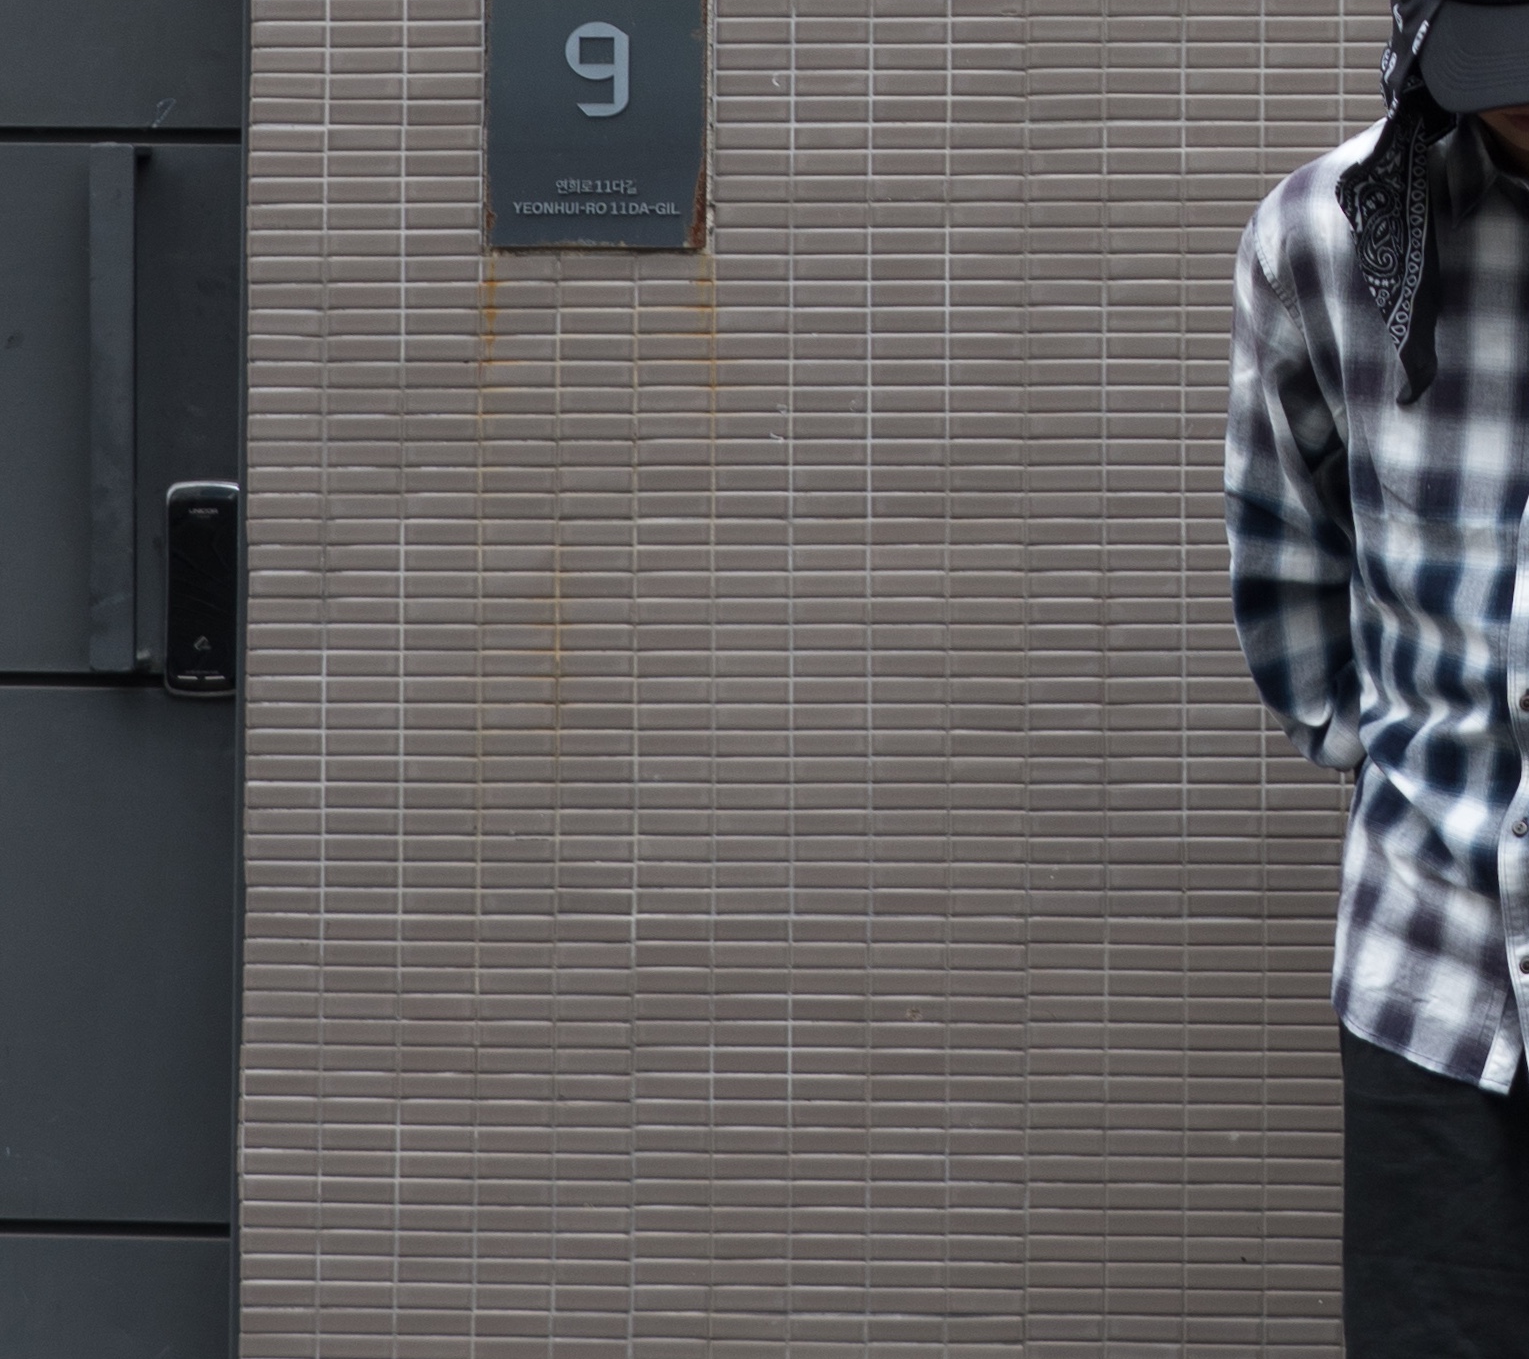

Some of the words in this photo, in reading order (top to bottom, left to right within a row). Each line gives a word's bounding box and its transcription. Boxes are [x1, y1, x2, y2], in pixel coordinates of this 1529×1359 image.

[565, 21, 629, 117] 9
[555, 178, 638, 195] 연희로11다길
[513, 201, 607, 215] YEONHUI-RO
[609, 201, 681, 215] 11DA-GIL
